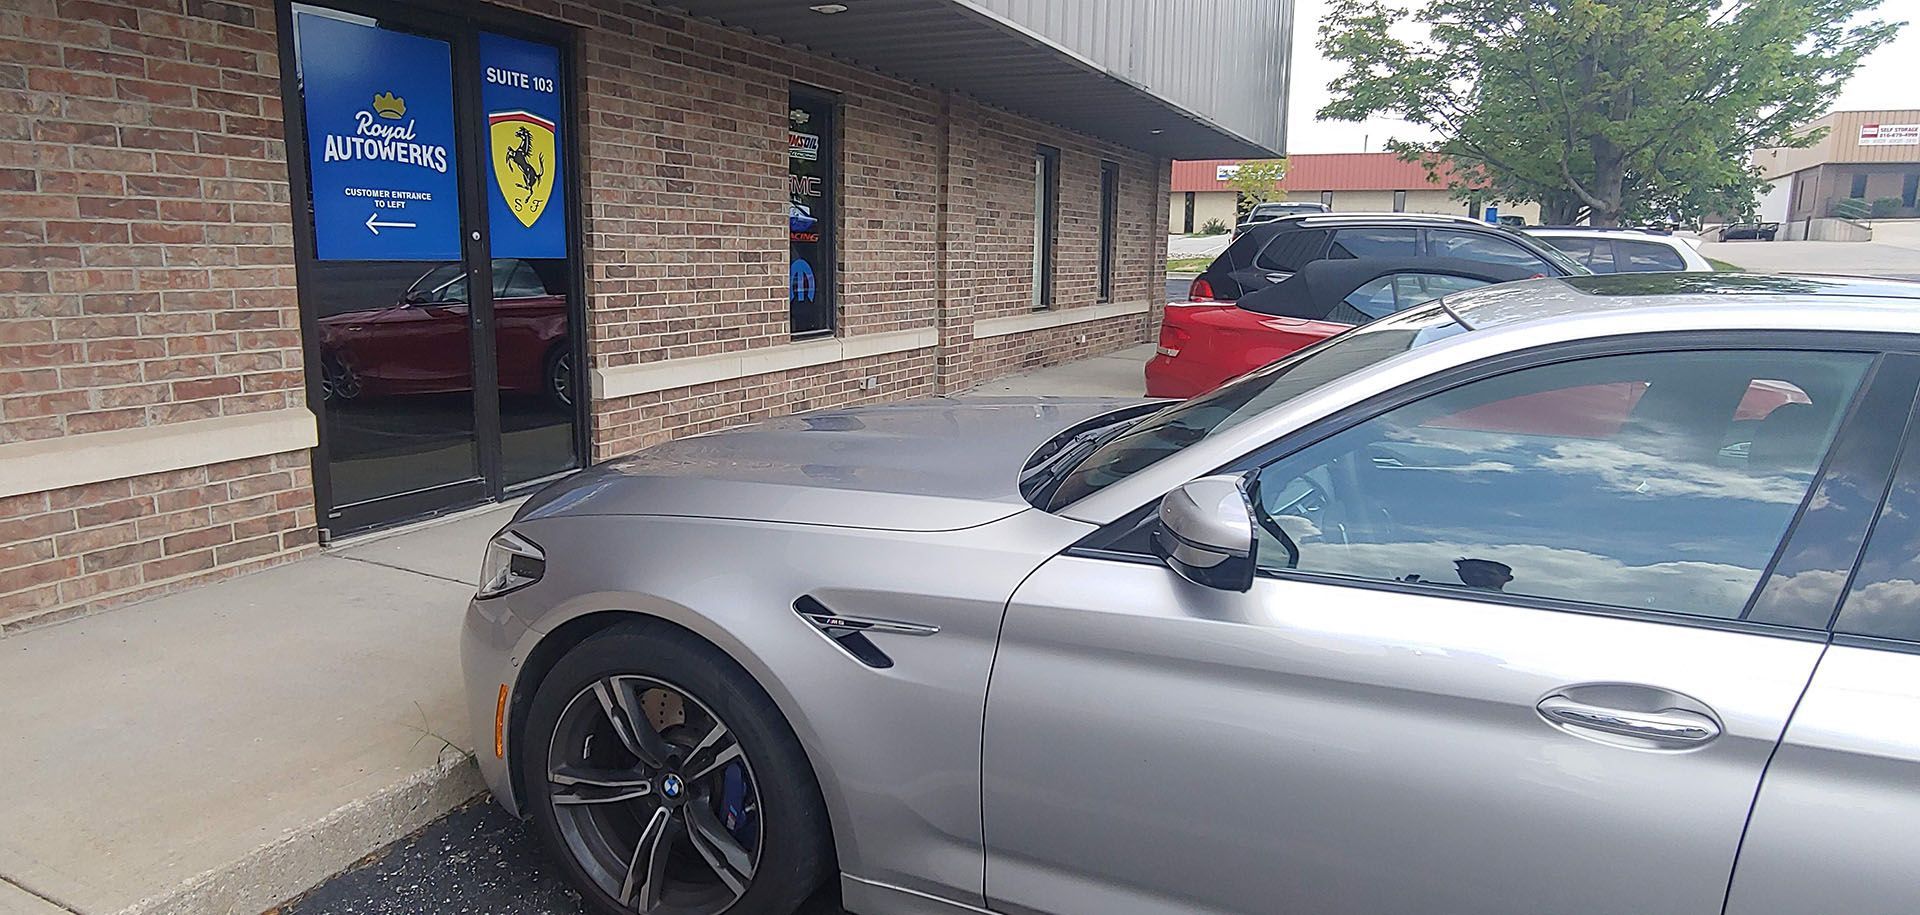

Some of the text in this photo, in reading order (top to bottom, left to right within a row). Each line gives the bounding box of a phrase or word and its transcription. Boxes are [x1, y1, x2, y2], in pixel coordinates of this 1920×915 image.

[486, 66, 554, 93] SUITE 103
[355, 110, 416, 146] Royal
[324, 135, 447, 173] AUTOWERKS
[344, 187, 432, 201] CUSTOMER ENTRANCE
[789, 174, 821, 197] MC
[374, 199, 406, 209] TO LEFT
[514, 198, 543, 213] S F
[789, 232, 819, 242] ACING
